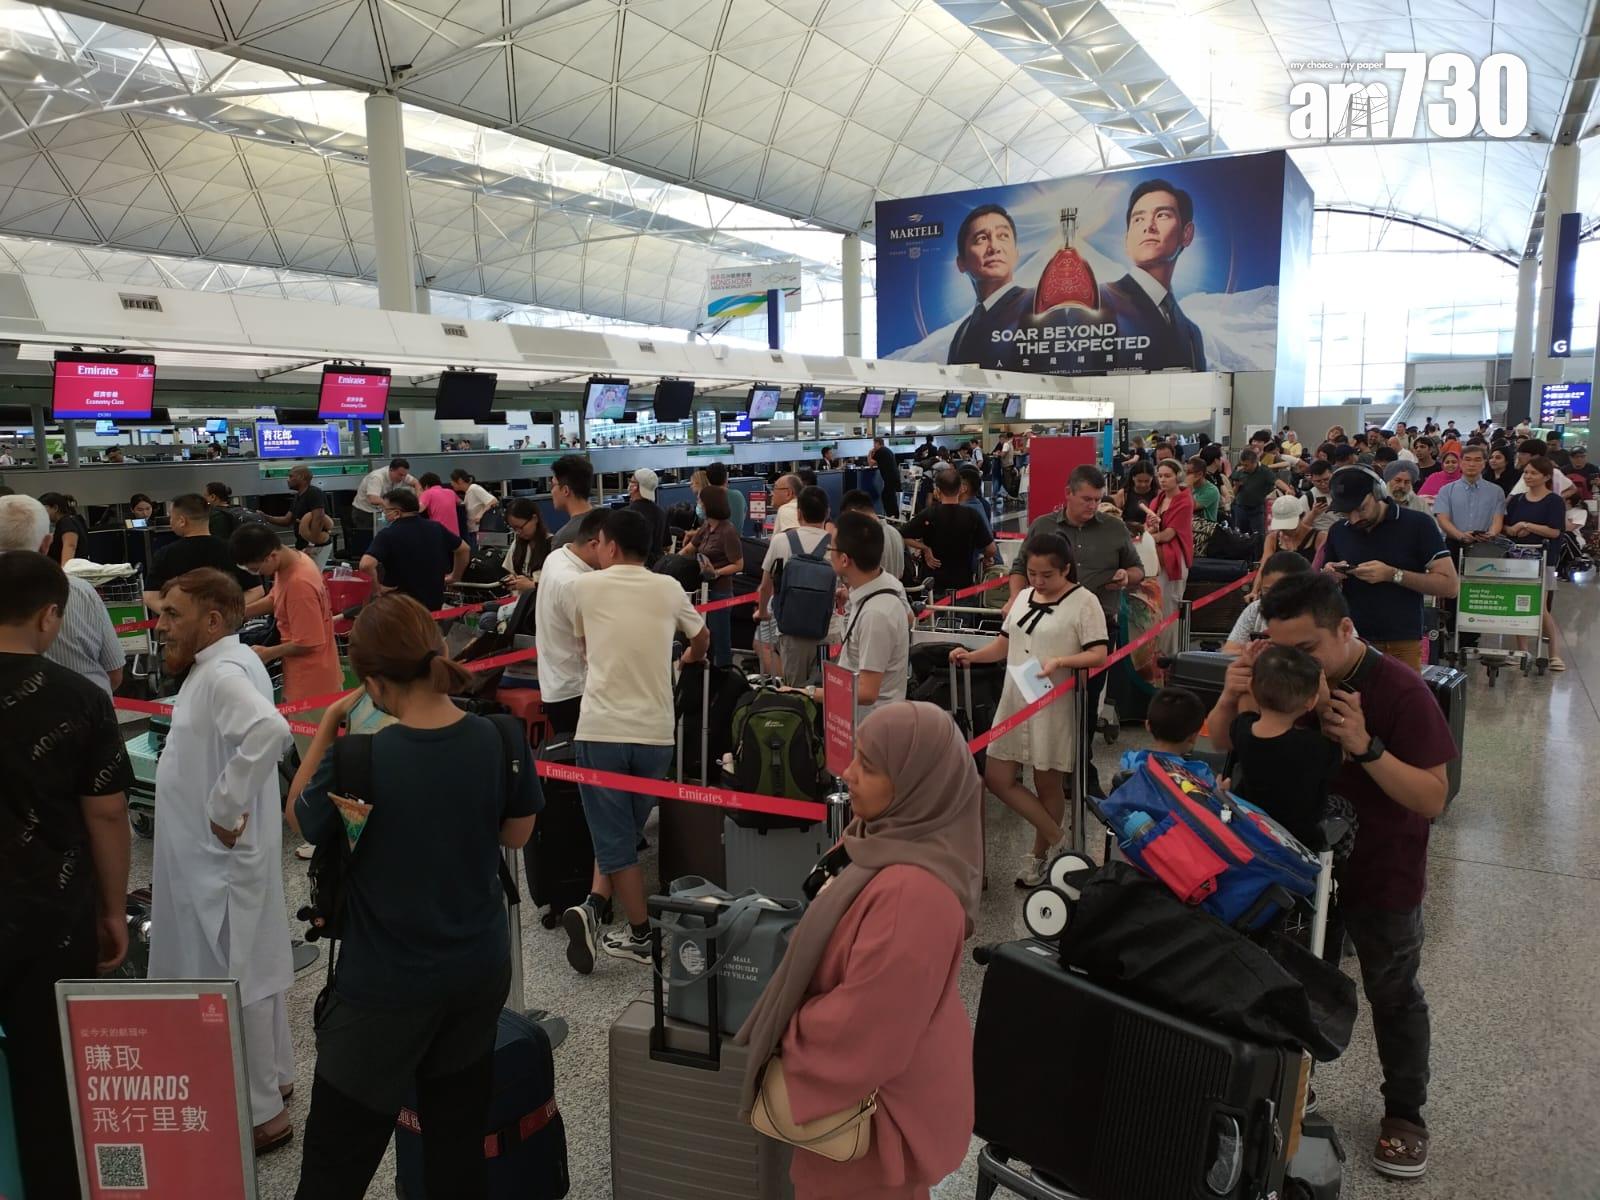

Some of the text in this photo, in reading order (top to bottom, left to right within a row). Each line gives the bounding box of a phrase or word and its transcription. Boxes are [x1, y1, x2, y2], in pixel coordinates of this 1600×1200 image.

[890, 225, 941, 240] MARTELL
[991, 323, 1117, 343] SOAR BEYOND
[1016, 336, 1150, 356] THE EXPECTED
[1553, 340, 1568, 353] G
[77, 365, 119, 376] Emirates
[338, 375, 366, 385] Emirates
[545, 764, 585, 783] Emirates
[678, 786, 723, 805] Emirates
[732, 955, 752, 964] MALL
[84, 1044, 144, 1071] 賺取
[87, 1074, 190, 1101] SKYWARDS
[92, 1105, 210, 1133] 飛行里數
